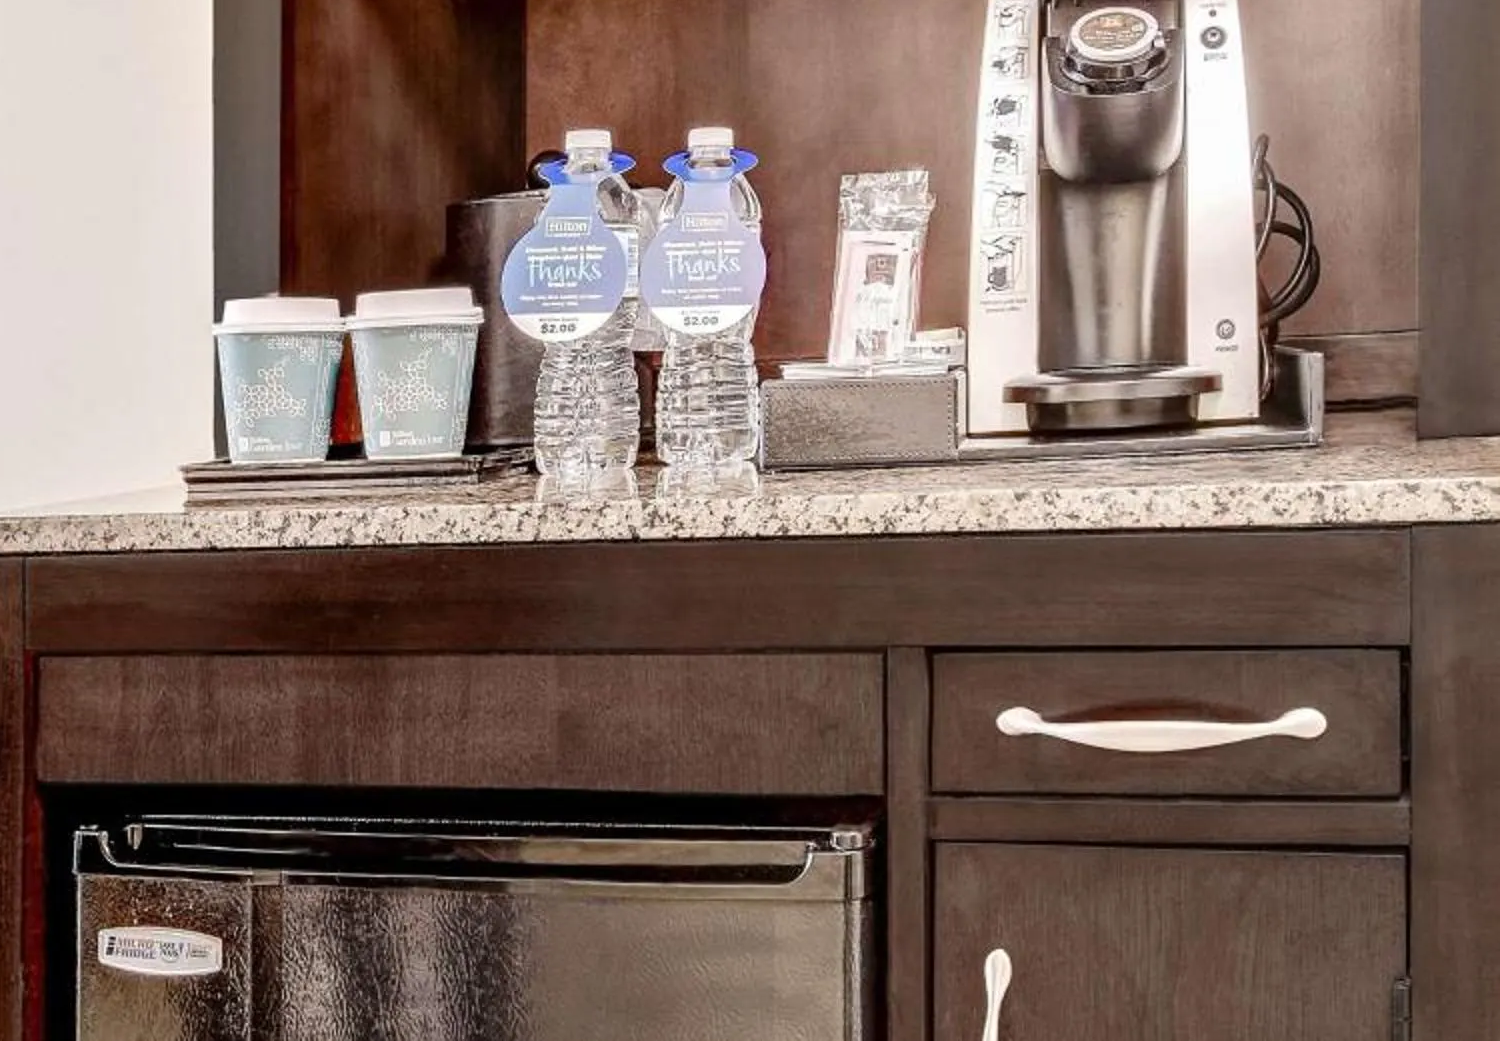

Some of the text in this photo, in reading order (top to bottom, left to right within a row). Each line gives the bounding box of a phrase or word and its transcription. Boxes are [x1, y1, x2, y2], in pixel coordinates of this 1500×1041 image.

[548, 221, 588, 233] Hilton
[528, 253, 603, 287] Thanks
[667, 246, 741, 282] Thanks
[683, 316, 719, 327] $2.00
[540, 323, 577, 334] $2.00
